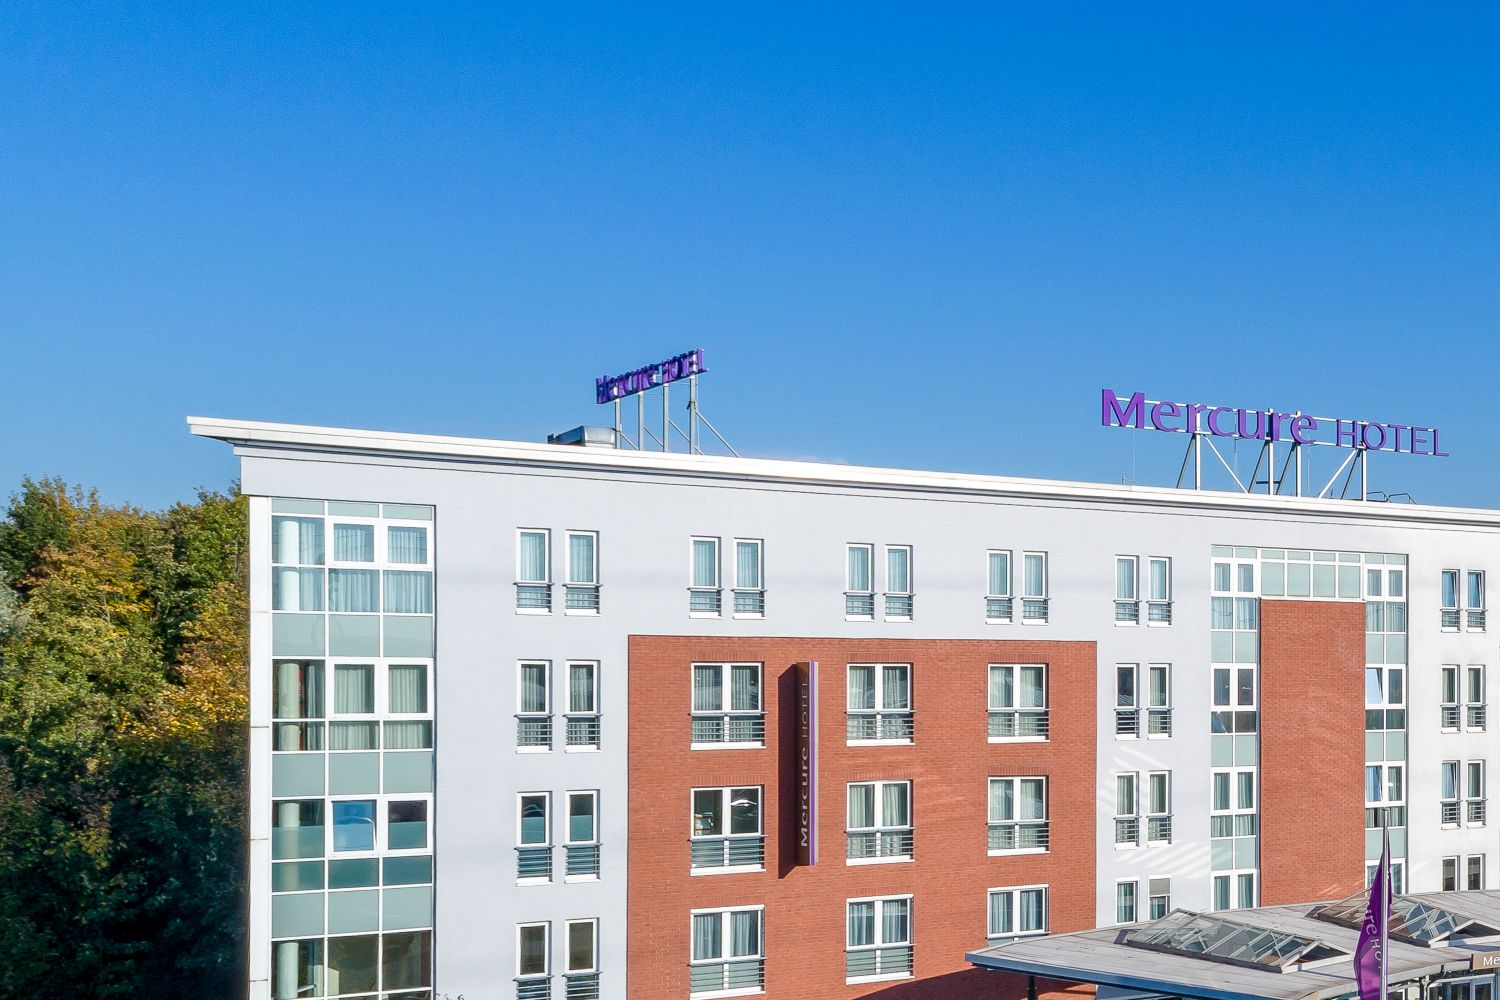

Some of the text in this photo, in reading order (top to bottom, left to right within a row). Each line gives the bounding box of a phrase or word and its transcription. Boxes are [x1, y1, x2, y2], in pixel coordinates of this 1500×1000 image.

[1102, 388, 1450, 457] Mercure HOTEL
[801, 747, 809, 847] Mercure
